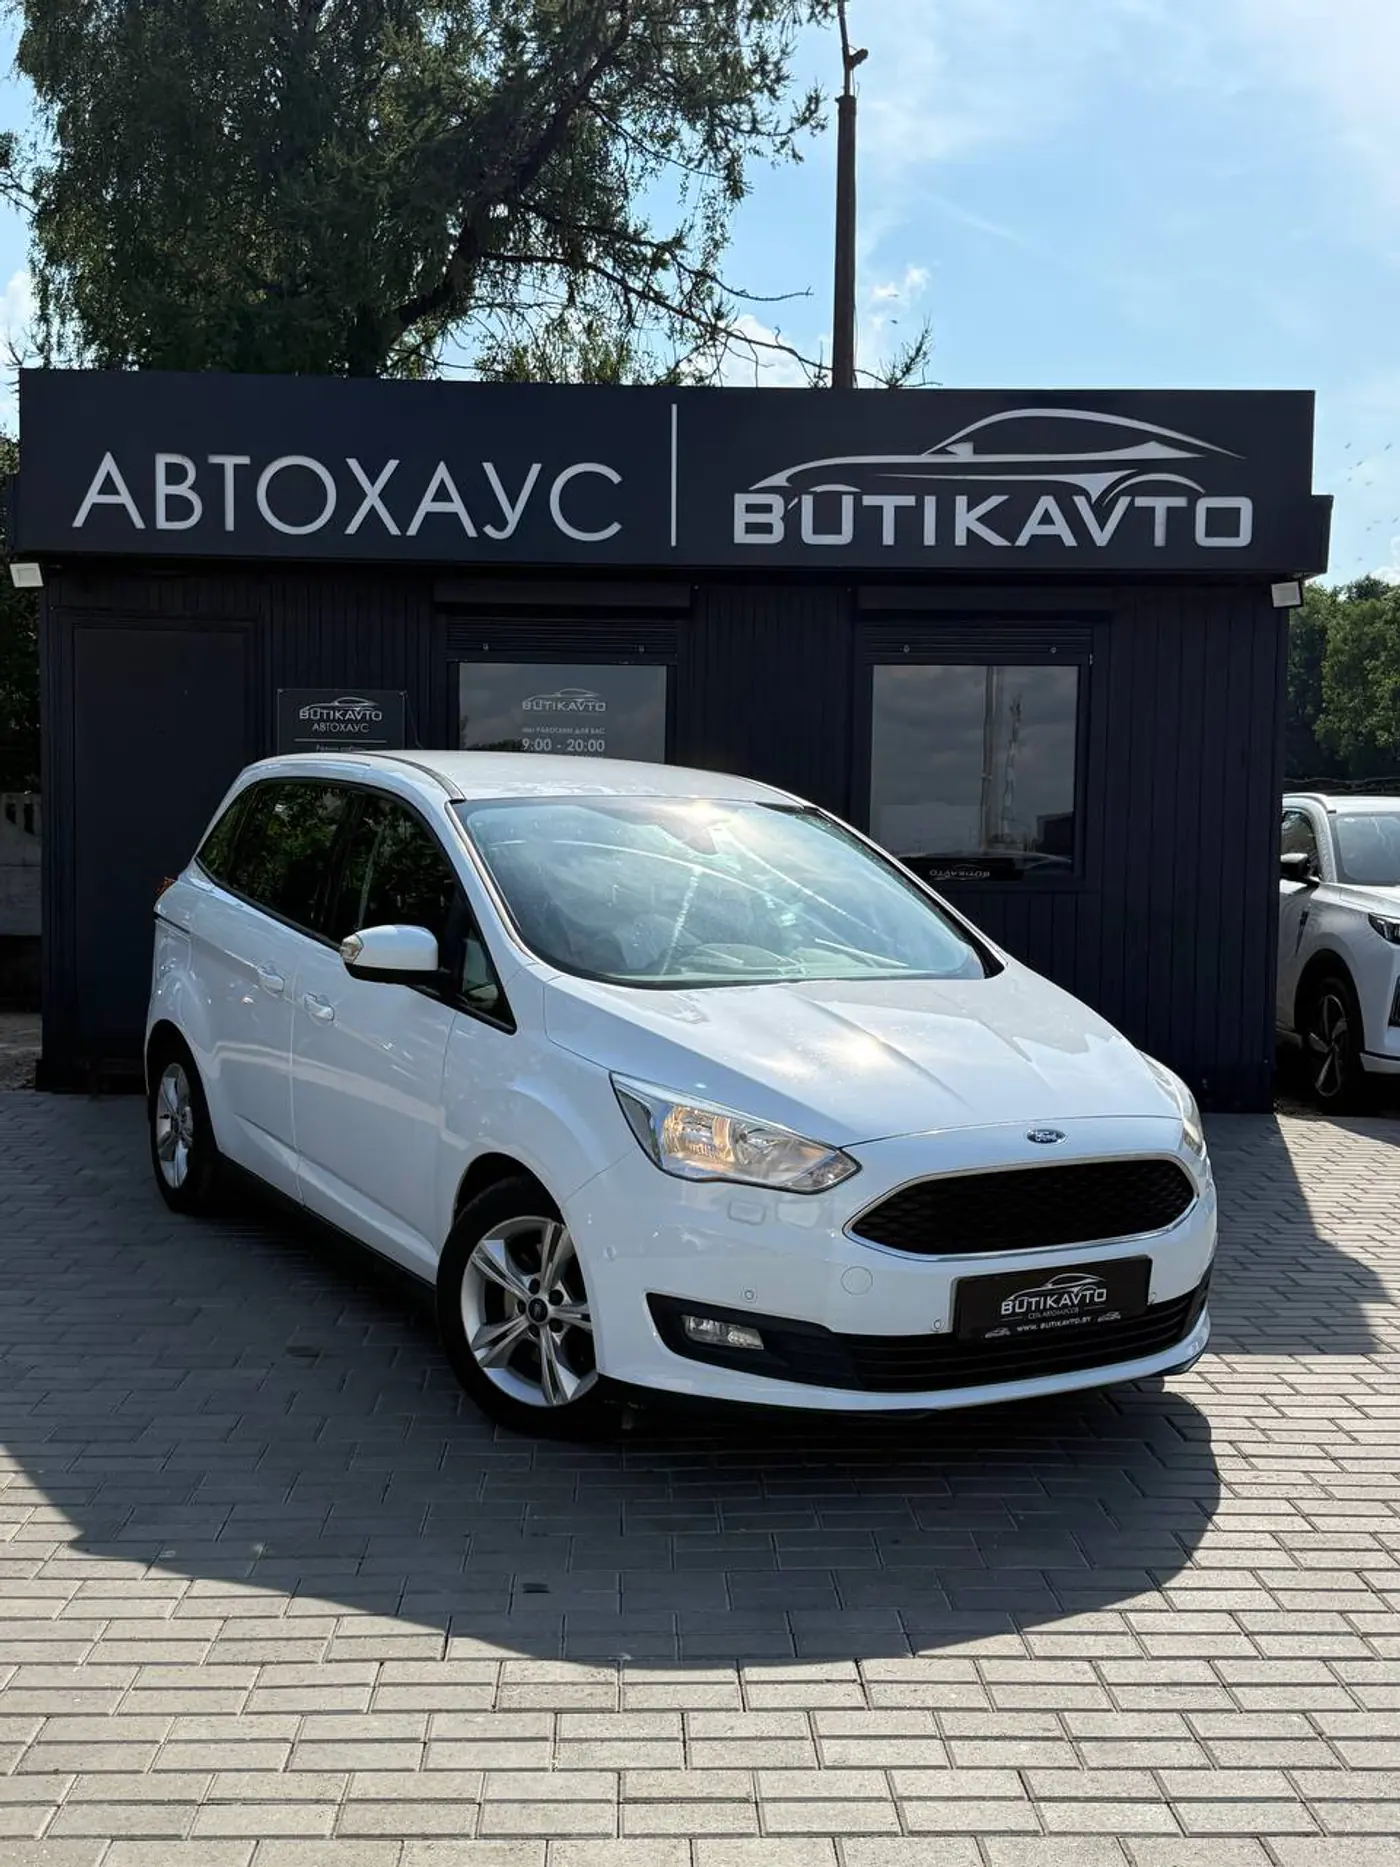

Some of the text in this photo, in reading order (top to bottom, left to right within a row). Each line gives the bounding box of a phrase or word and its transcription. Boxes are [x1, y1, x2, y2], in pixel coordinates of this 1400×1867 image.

[71, 451, 623, 542] АВТОХАУС
[733, 492, 1253, 548] BUTIKAVTO
[522, 700, 607, 713] BUTIKAVTO
[299, 708, 383, 721] BUTIKAVTO
[312, 722, 370, 733] АВТОХАУС
[522, 738, 552, 751] 9:00
[566, 739, 606, 753] 20:00
[1001, 1288, 1107, 1316] BUTIKAVTO
